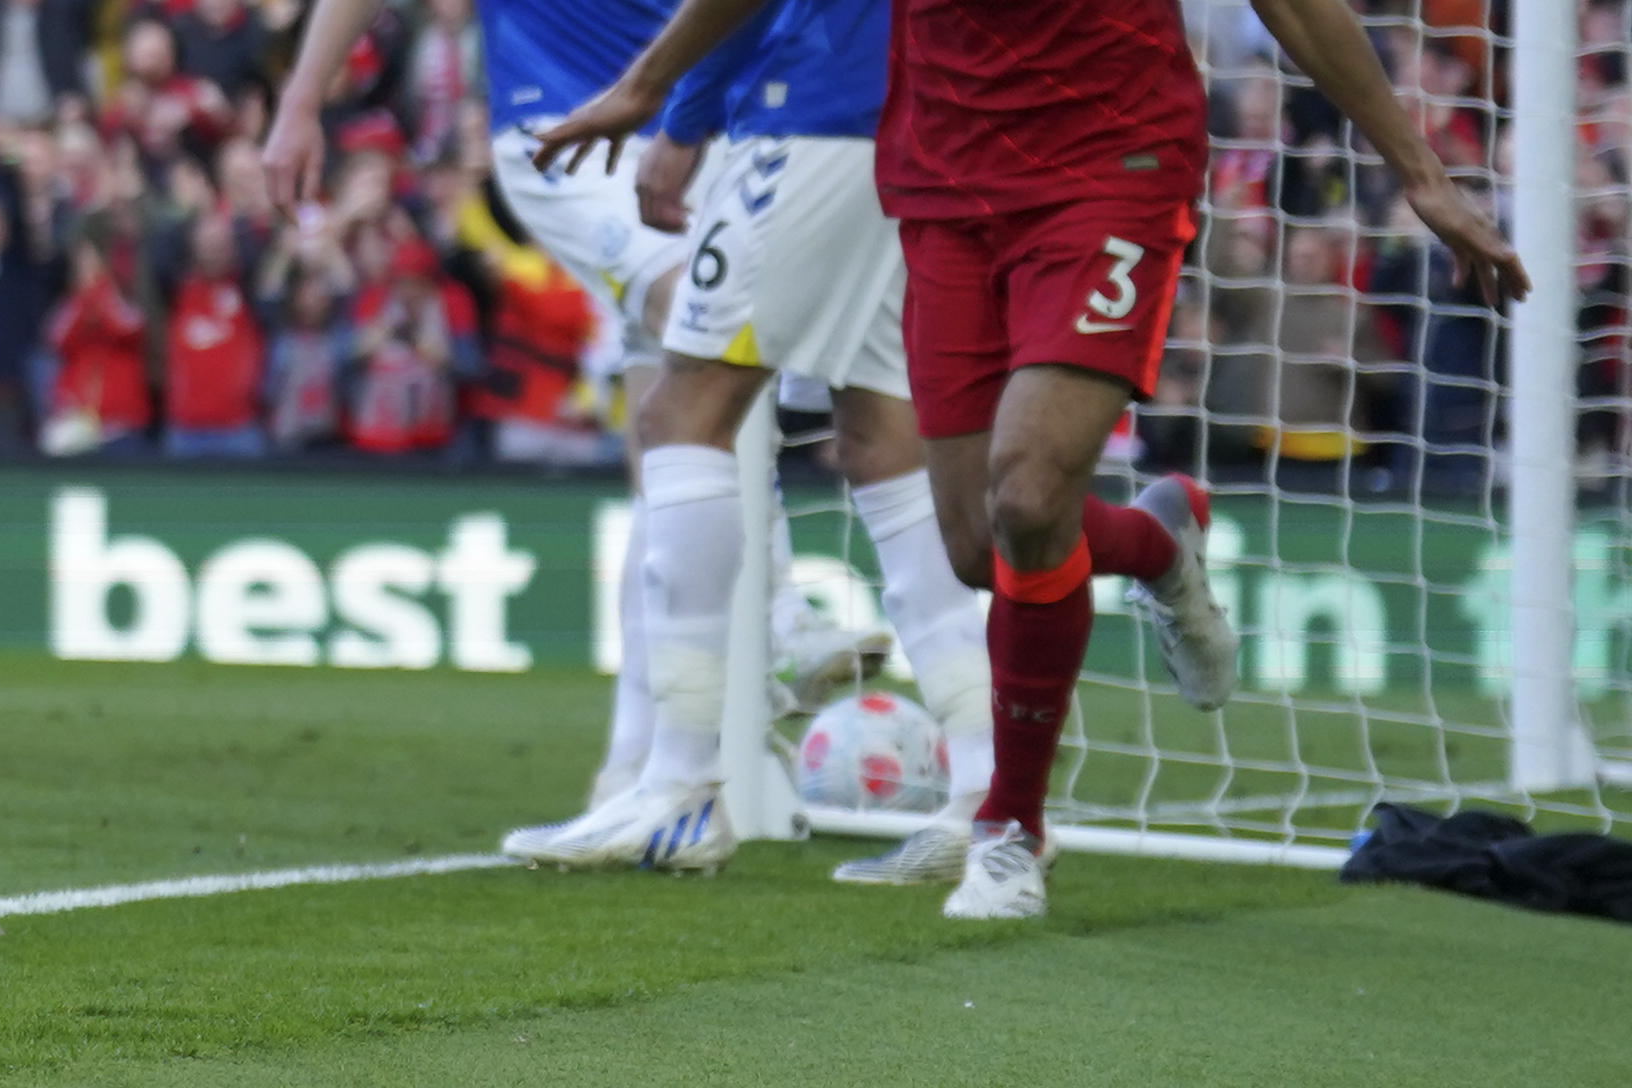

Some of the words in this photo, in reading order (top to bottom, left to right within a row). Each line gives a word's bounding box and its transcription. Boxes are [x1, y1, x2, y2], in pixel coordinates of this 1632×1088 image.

[691, 219, 730, 291] 6
[1088, 235, 1145, 319] 3
[49, 485, 537, 672] best
